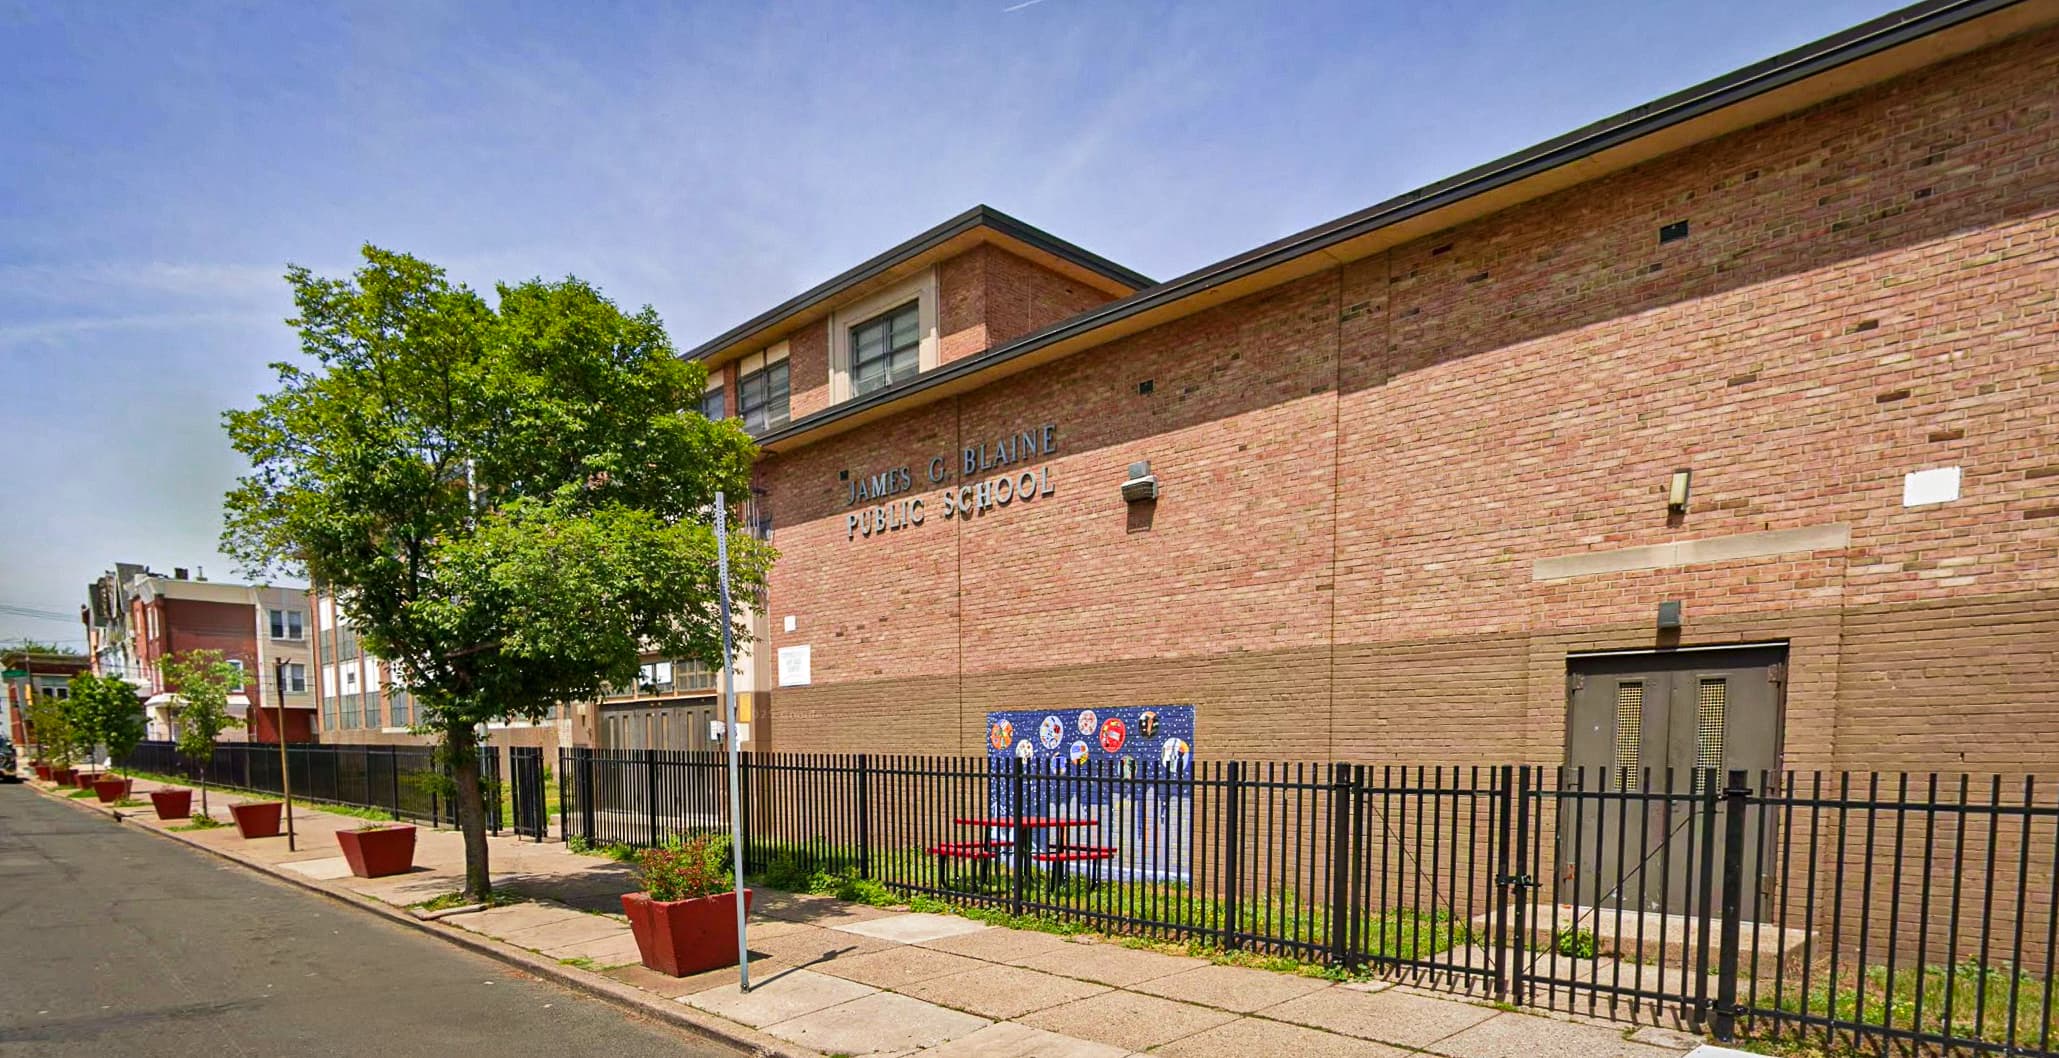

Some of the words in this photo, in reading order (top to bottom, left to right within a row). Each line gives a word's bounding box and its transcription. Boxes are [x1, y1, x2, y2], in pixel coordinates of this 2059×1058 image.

[847, 498, 924, 538] PUBLIC
[944, 466, 1056, 517] SCHOOL
[848, 466, 911, 505] JAMES
[964, 423, 1057, 475] BLAINE
